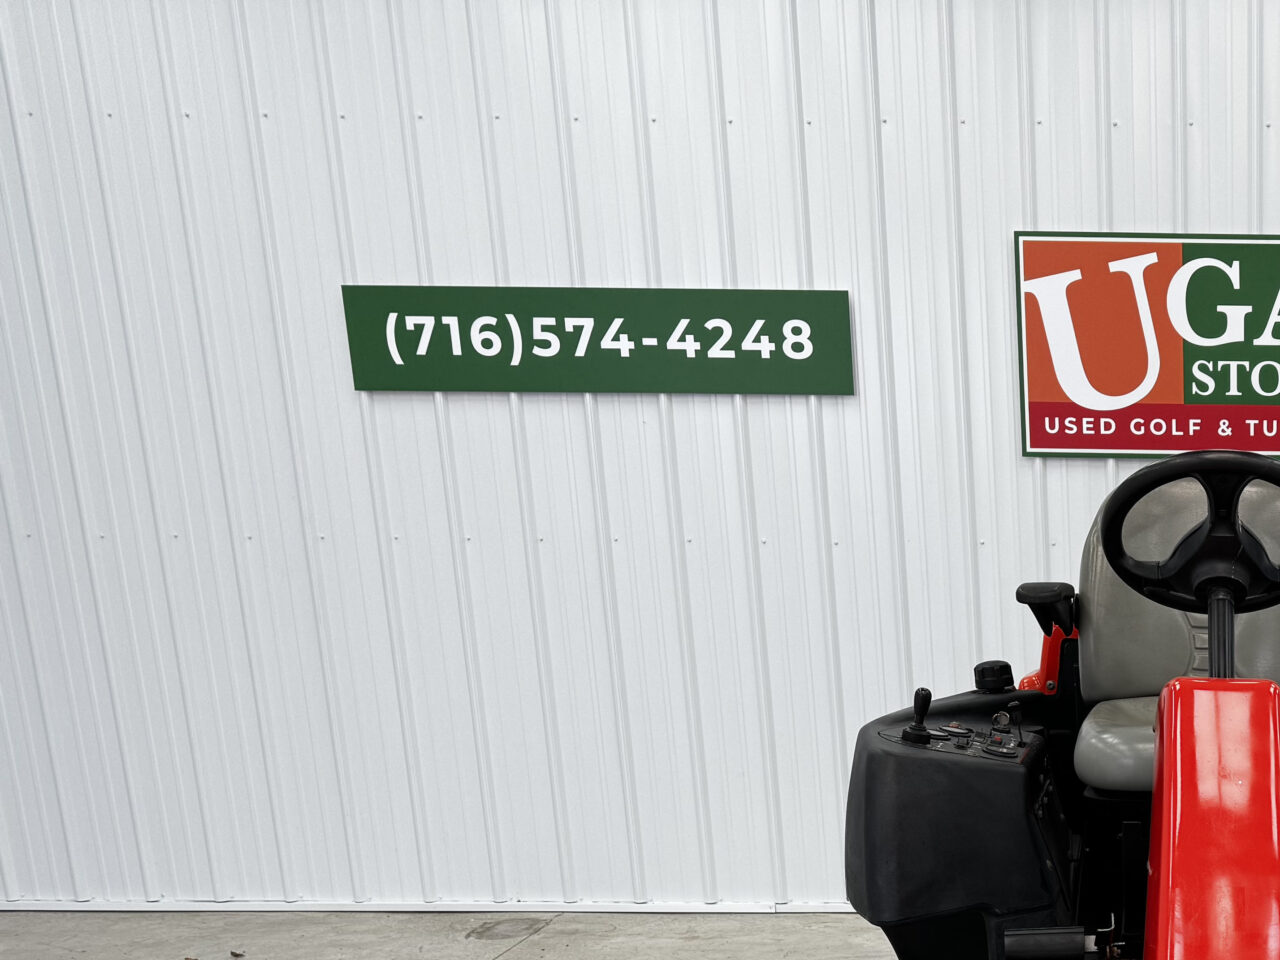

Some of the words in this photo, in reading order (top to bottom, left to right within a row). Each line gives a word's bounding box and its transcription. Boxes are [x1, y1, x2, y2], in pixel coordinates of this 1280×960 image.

[385, 312, 814, 366] (716)574-4248
[1044, 416, 1116, 435] USED
[1129, 417, 1202, 436] GOLF
[1217, 419, 1233, 437] &
